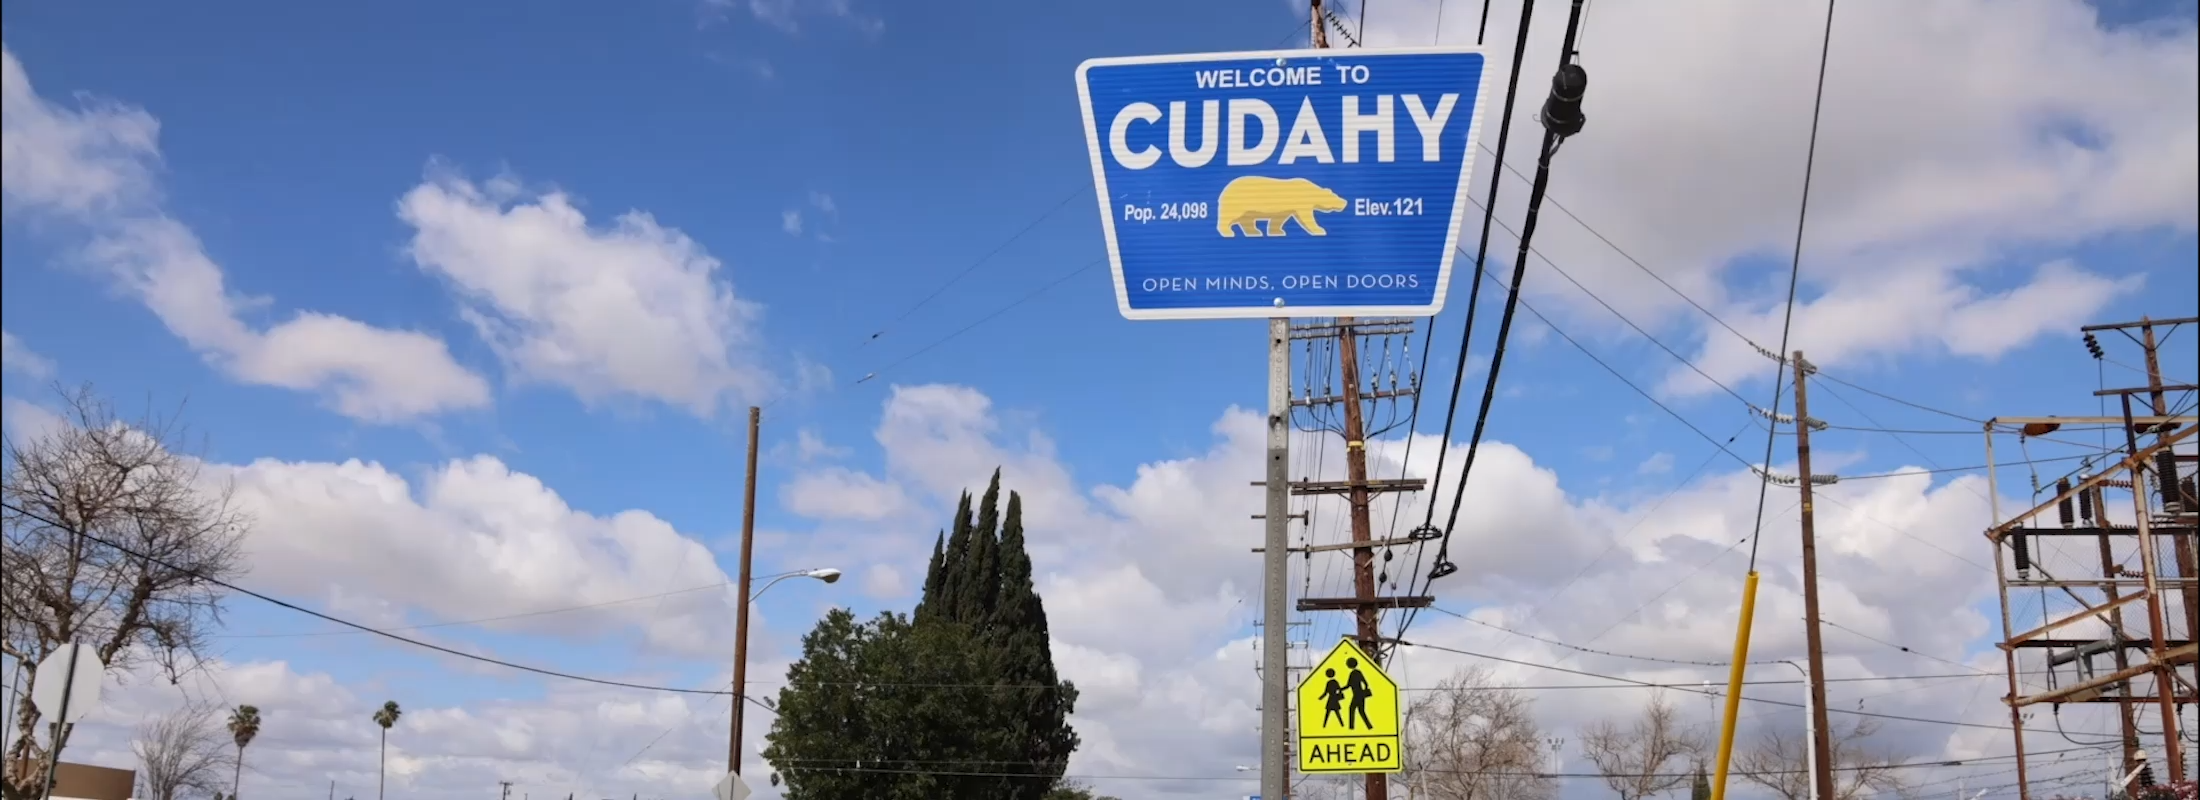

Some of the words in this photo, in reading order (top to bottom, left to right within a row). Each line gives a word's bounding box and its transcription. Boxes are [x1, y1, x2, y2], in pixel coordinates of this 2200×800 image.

[1195, 66, 1322, 88] WELCOME
[1335, 64, 1370, 85] TO
[1108, 92, 1460, 170] CUDAHY
[1124, 203, 1156, 225] Pop.
[1160, 202, 1208, 222] 24,098
[1142, 277, 1197, 292] OPEN
[1205, 276, 1275, 291] MINDS,
[1282, 274, 1338, 290] OPEN
[1347, 273, 1419, 288] DOORS
[1308, 743, 1391, 763] AHEAD
